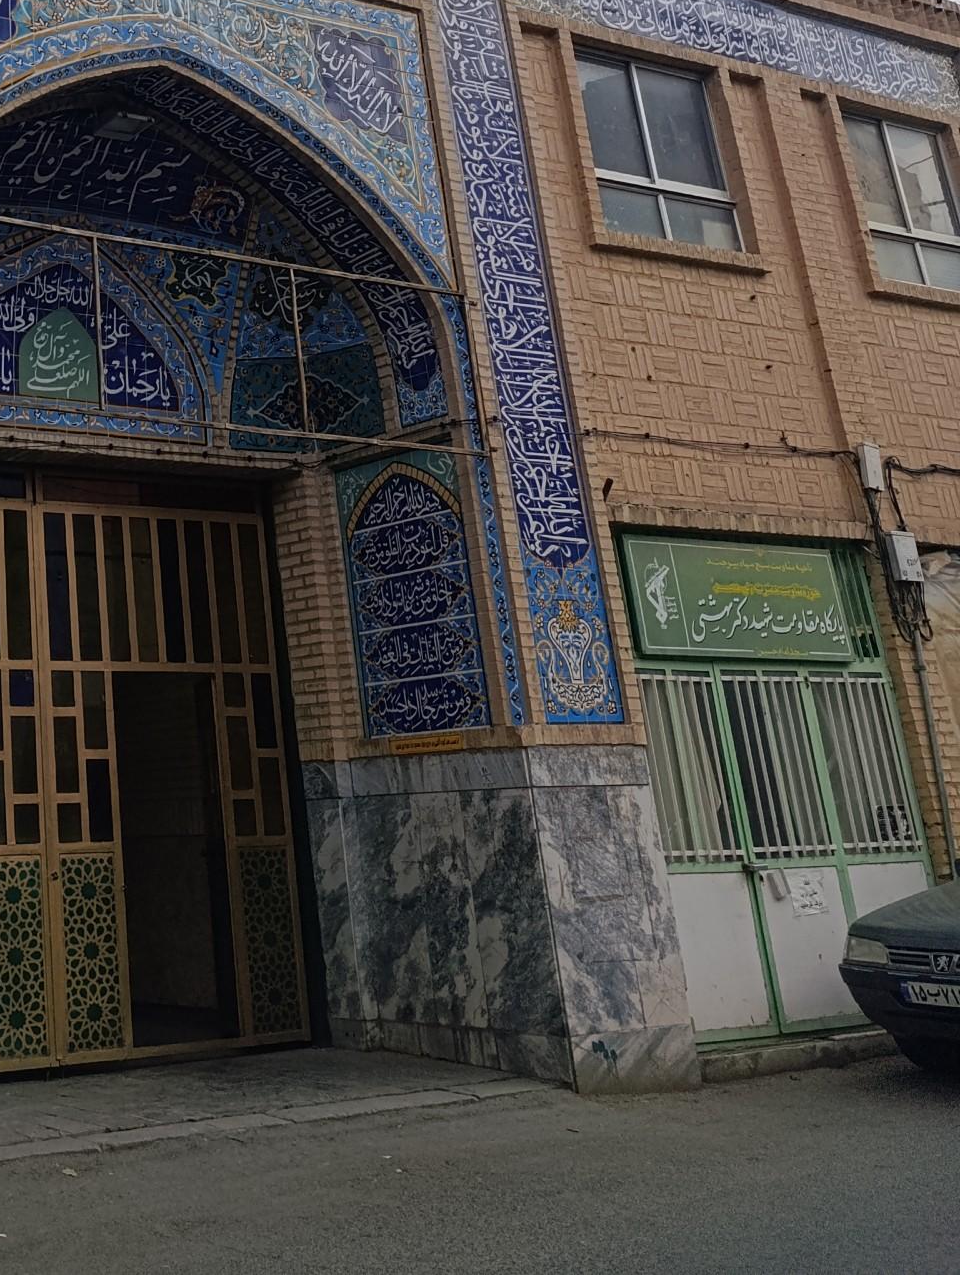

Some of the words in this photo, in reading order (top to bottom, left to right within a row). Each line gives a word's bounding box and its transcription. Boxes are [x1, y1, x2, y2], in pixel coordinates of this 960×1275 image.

[692, 594, 732, 643] بهشتی
[748, 602, 773, 638] شهید
[775, 607, 821, 636] مقاومت
[820, 604, 846, 645] پایگاه
